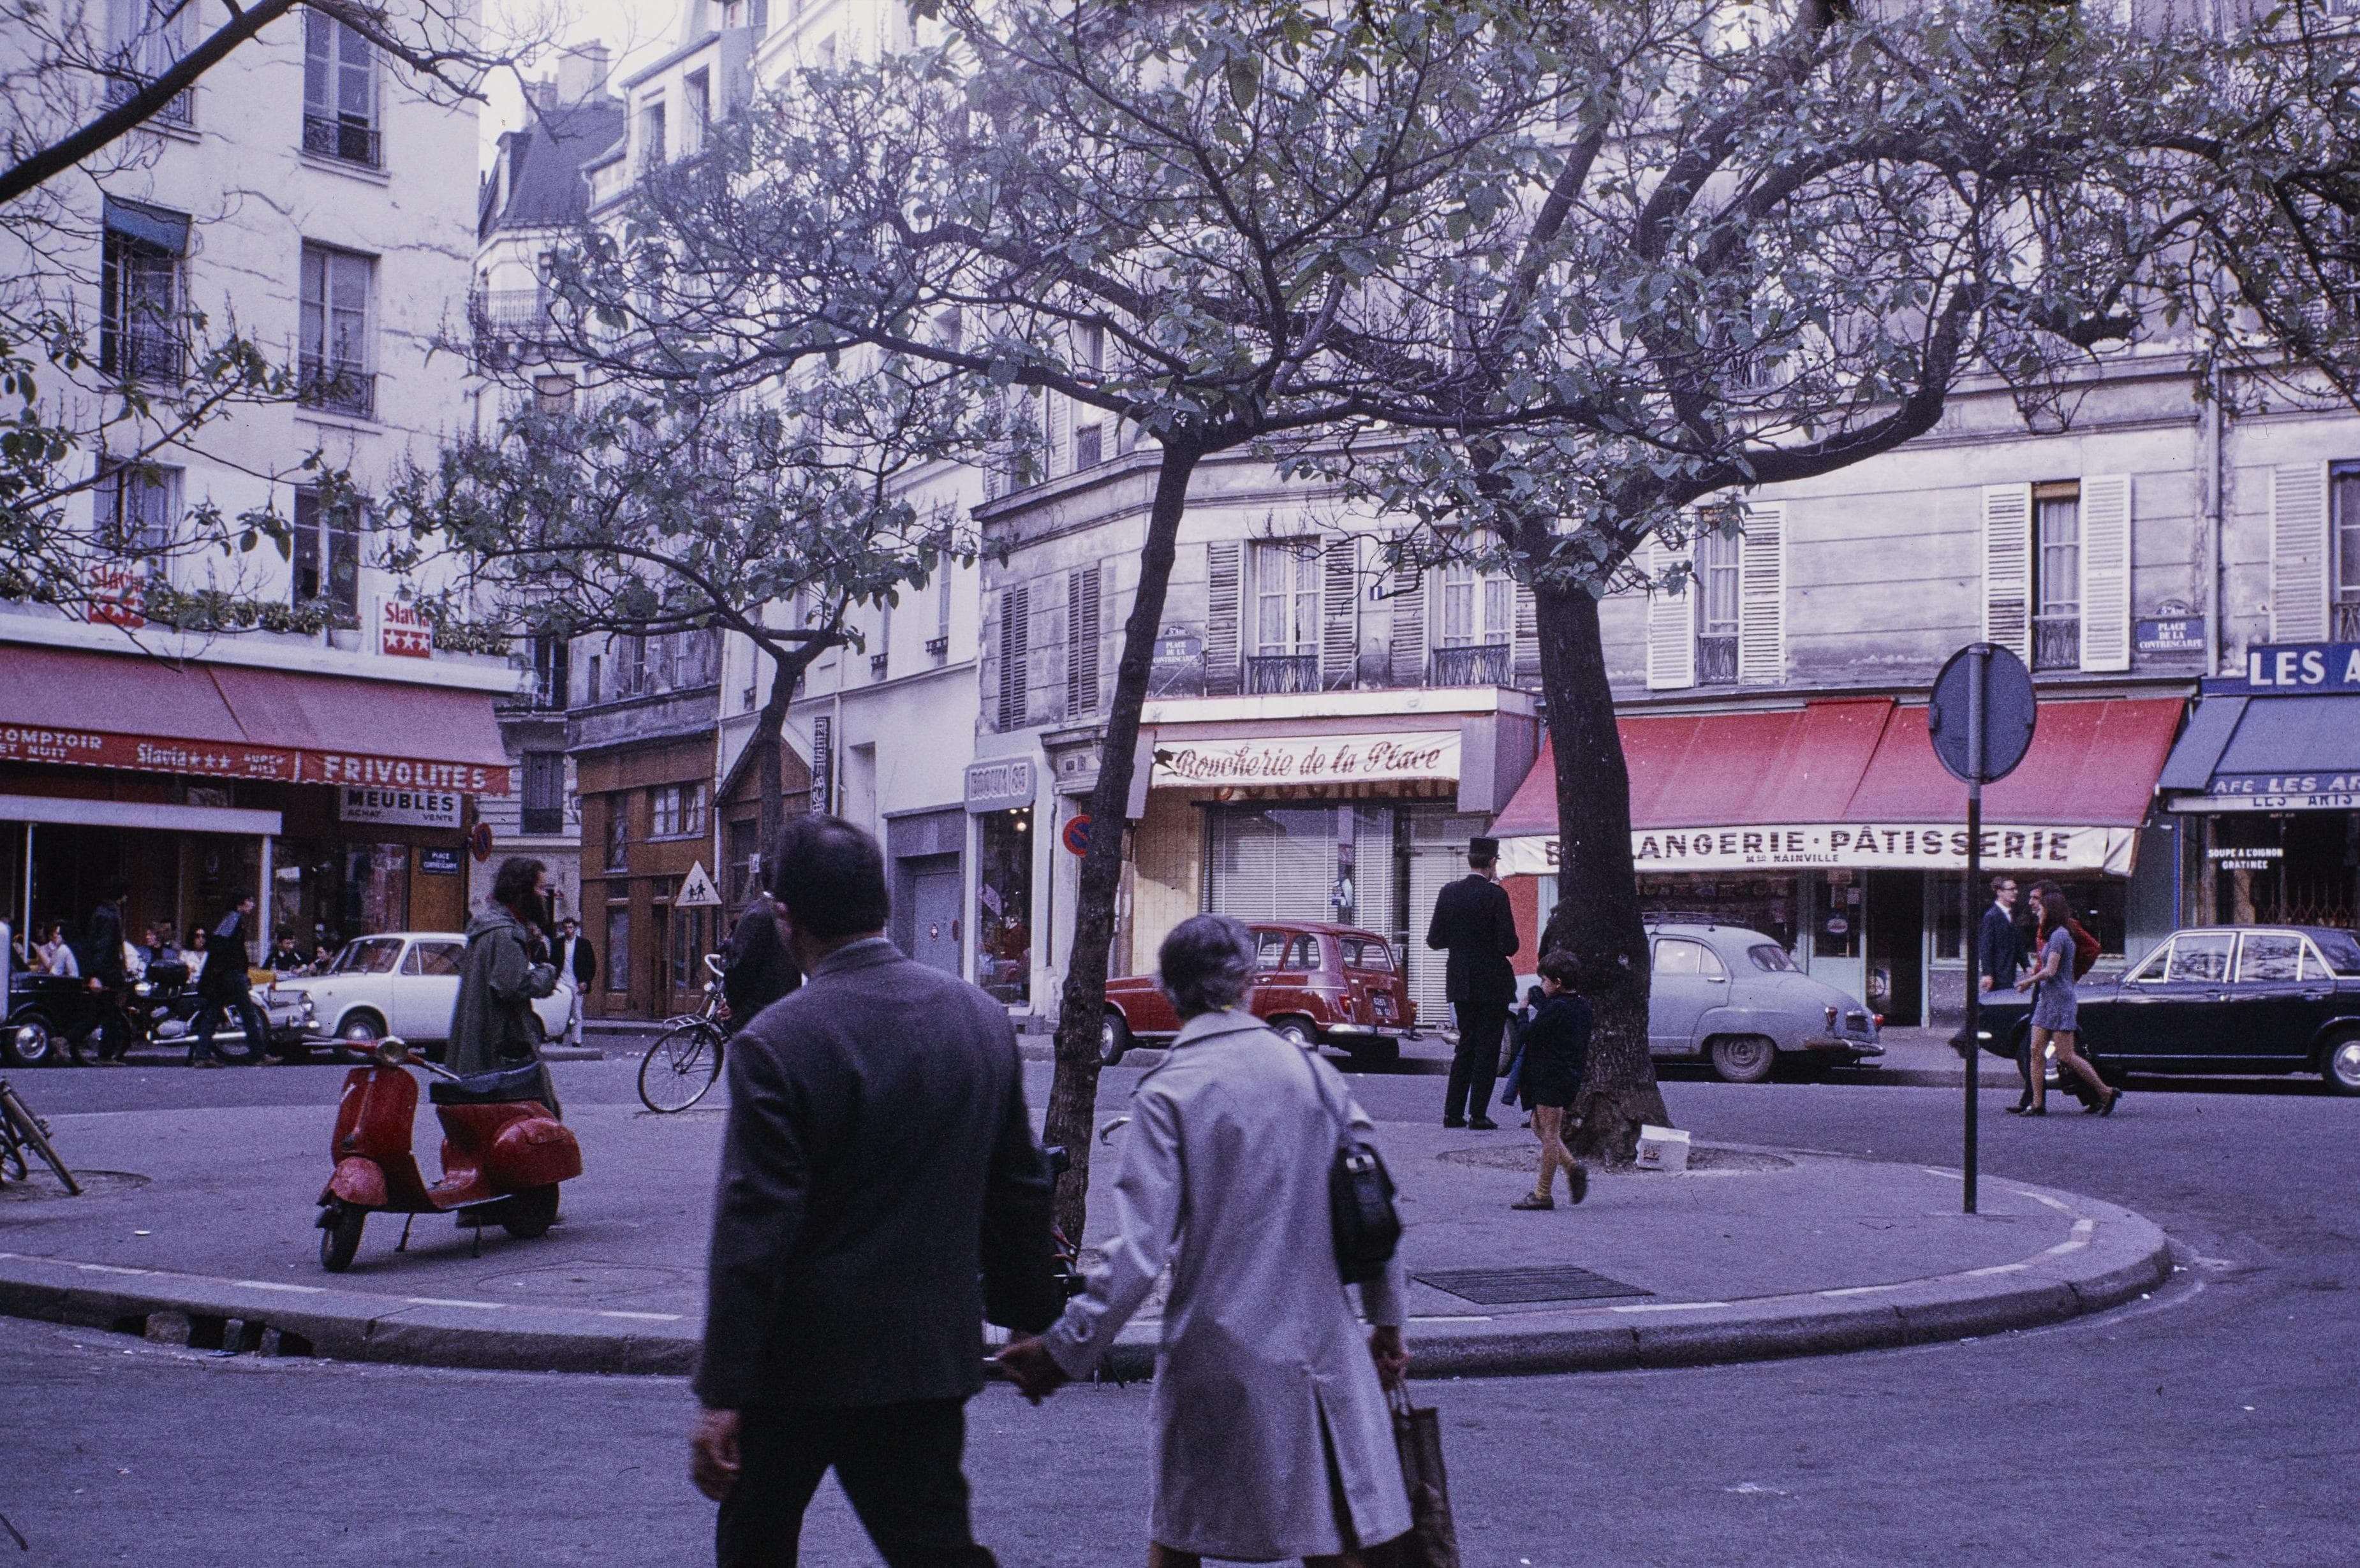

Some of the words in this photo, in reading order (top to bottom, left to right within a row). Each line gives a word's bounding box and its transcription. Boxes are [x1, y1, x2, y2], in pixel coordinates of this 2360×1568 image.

[384, 601, 430, 627] Slava
[2158, 622, 2187, 631] PLACE
[2172, 631, 2185, 639] LA
[2139, 639, 2203, 648] CONTRESCARPE
[2250, 650, 2325, 685] LES
[0, 729, 102, 749] OMPTOIR
[27, 745, 67, 758] NUIT
[136, 743, 187, 766] Slavia
[1176, 746, 1294, 778] Boucherie
[1300, 746, 1325, 775] de
[1331, 744, 1357, 773] la
[1364, 741, 1440, 772] Place
[813, 720, 827, 816] RESTAUR
[2267, 777, 2317, 793] LES
[2328, 775, 2360, 791] AR
[348, 789, 454, 812] MEUBLES
[424, 814, 454, 822] VENTE
[1545, 830, 1804, 866] BANGERIE
[1831, 826, 2070, 861] PÂTISSERIE
[2208, 849, 2236, 858] SOUPE
[2238, 848, 2245, 857] A
[2246, 848, 2283, 857] L'OIGNON
